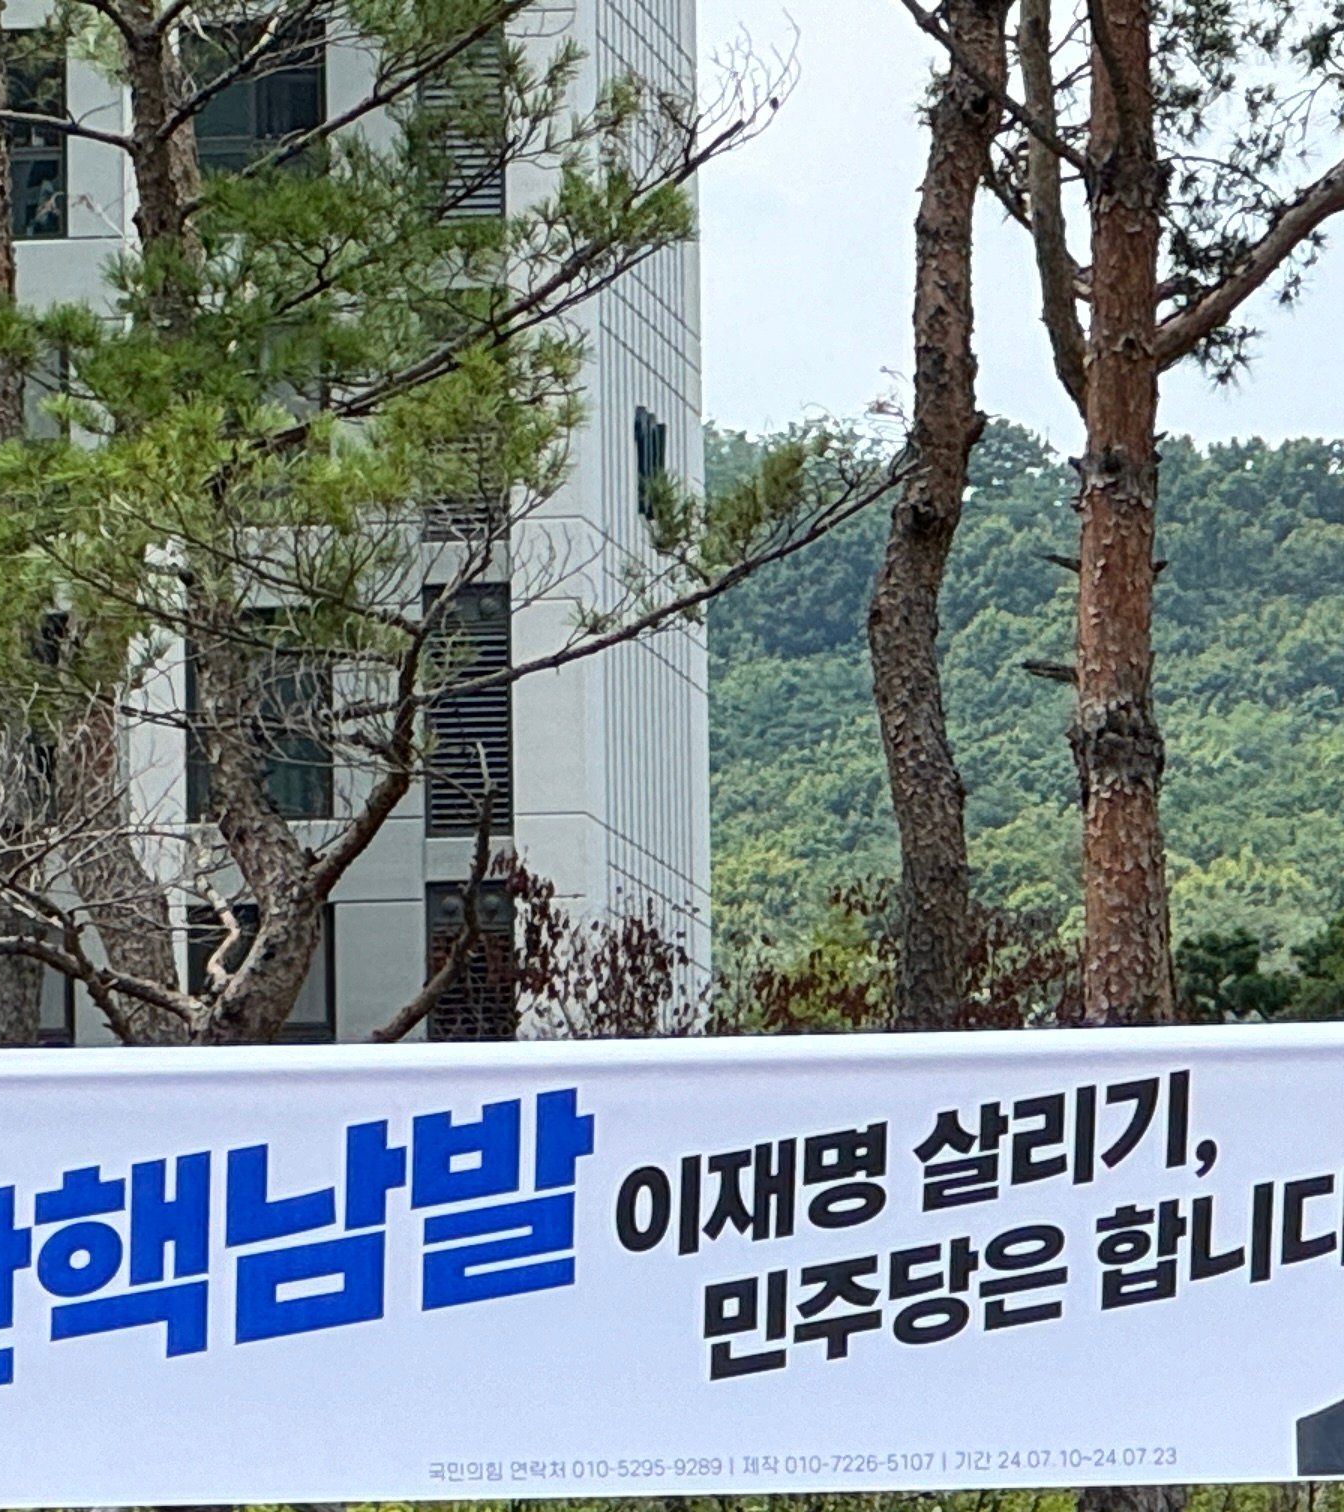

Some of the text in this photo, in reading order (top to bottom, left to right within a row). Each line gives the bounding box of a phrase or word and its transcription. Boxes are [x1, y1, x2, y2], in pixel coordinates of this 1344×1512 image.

[615, 1068, 1218, 1256] 이재명 살리기,
[703, 1223, 1070, 1381] 민주당은
[428, 1460, 503, 1482] 국민의힘
[510, 1460, 567, 1481] 연락처
[571, 1456, 723, 1479] 010-5295-9289
[742, 1454, 780, 1475] 제작
[784, 1451, 935, 1474] 010-7226-5107
[955, 1449, 992, 1471] 기간
